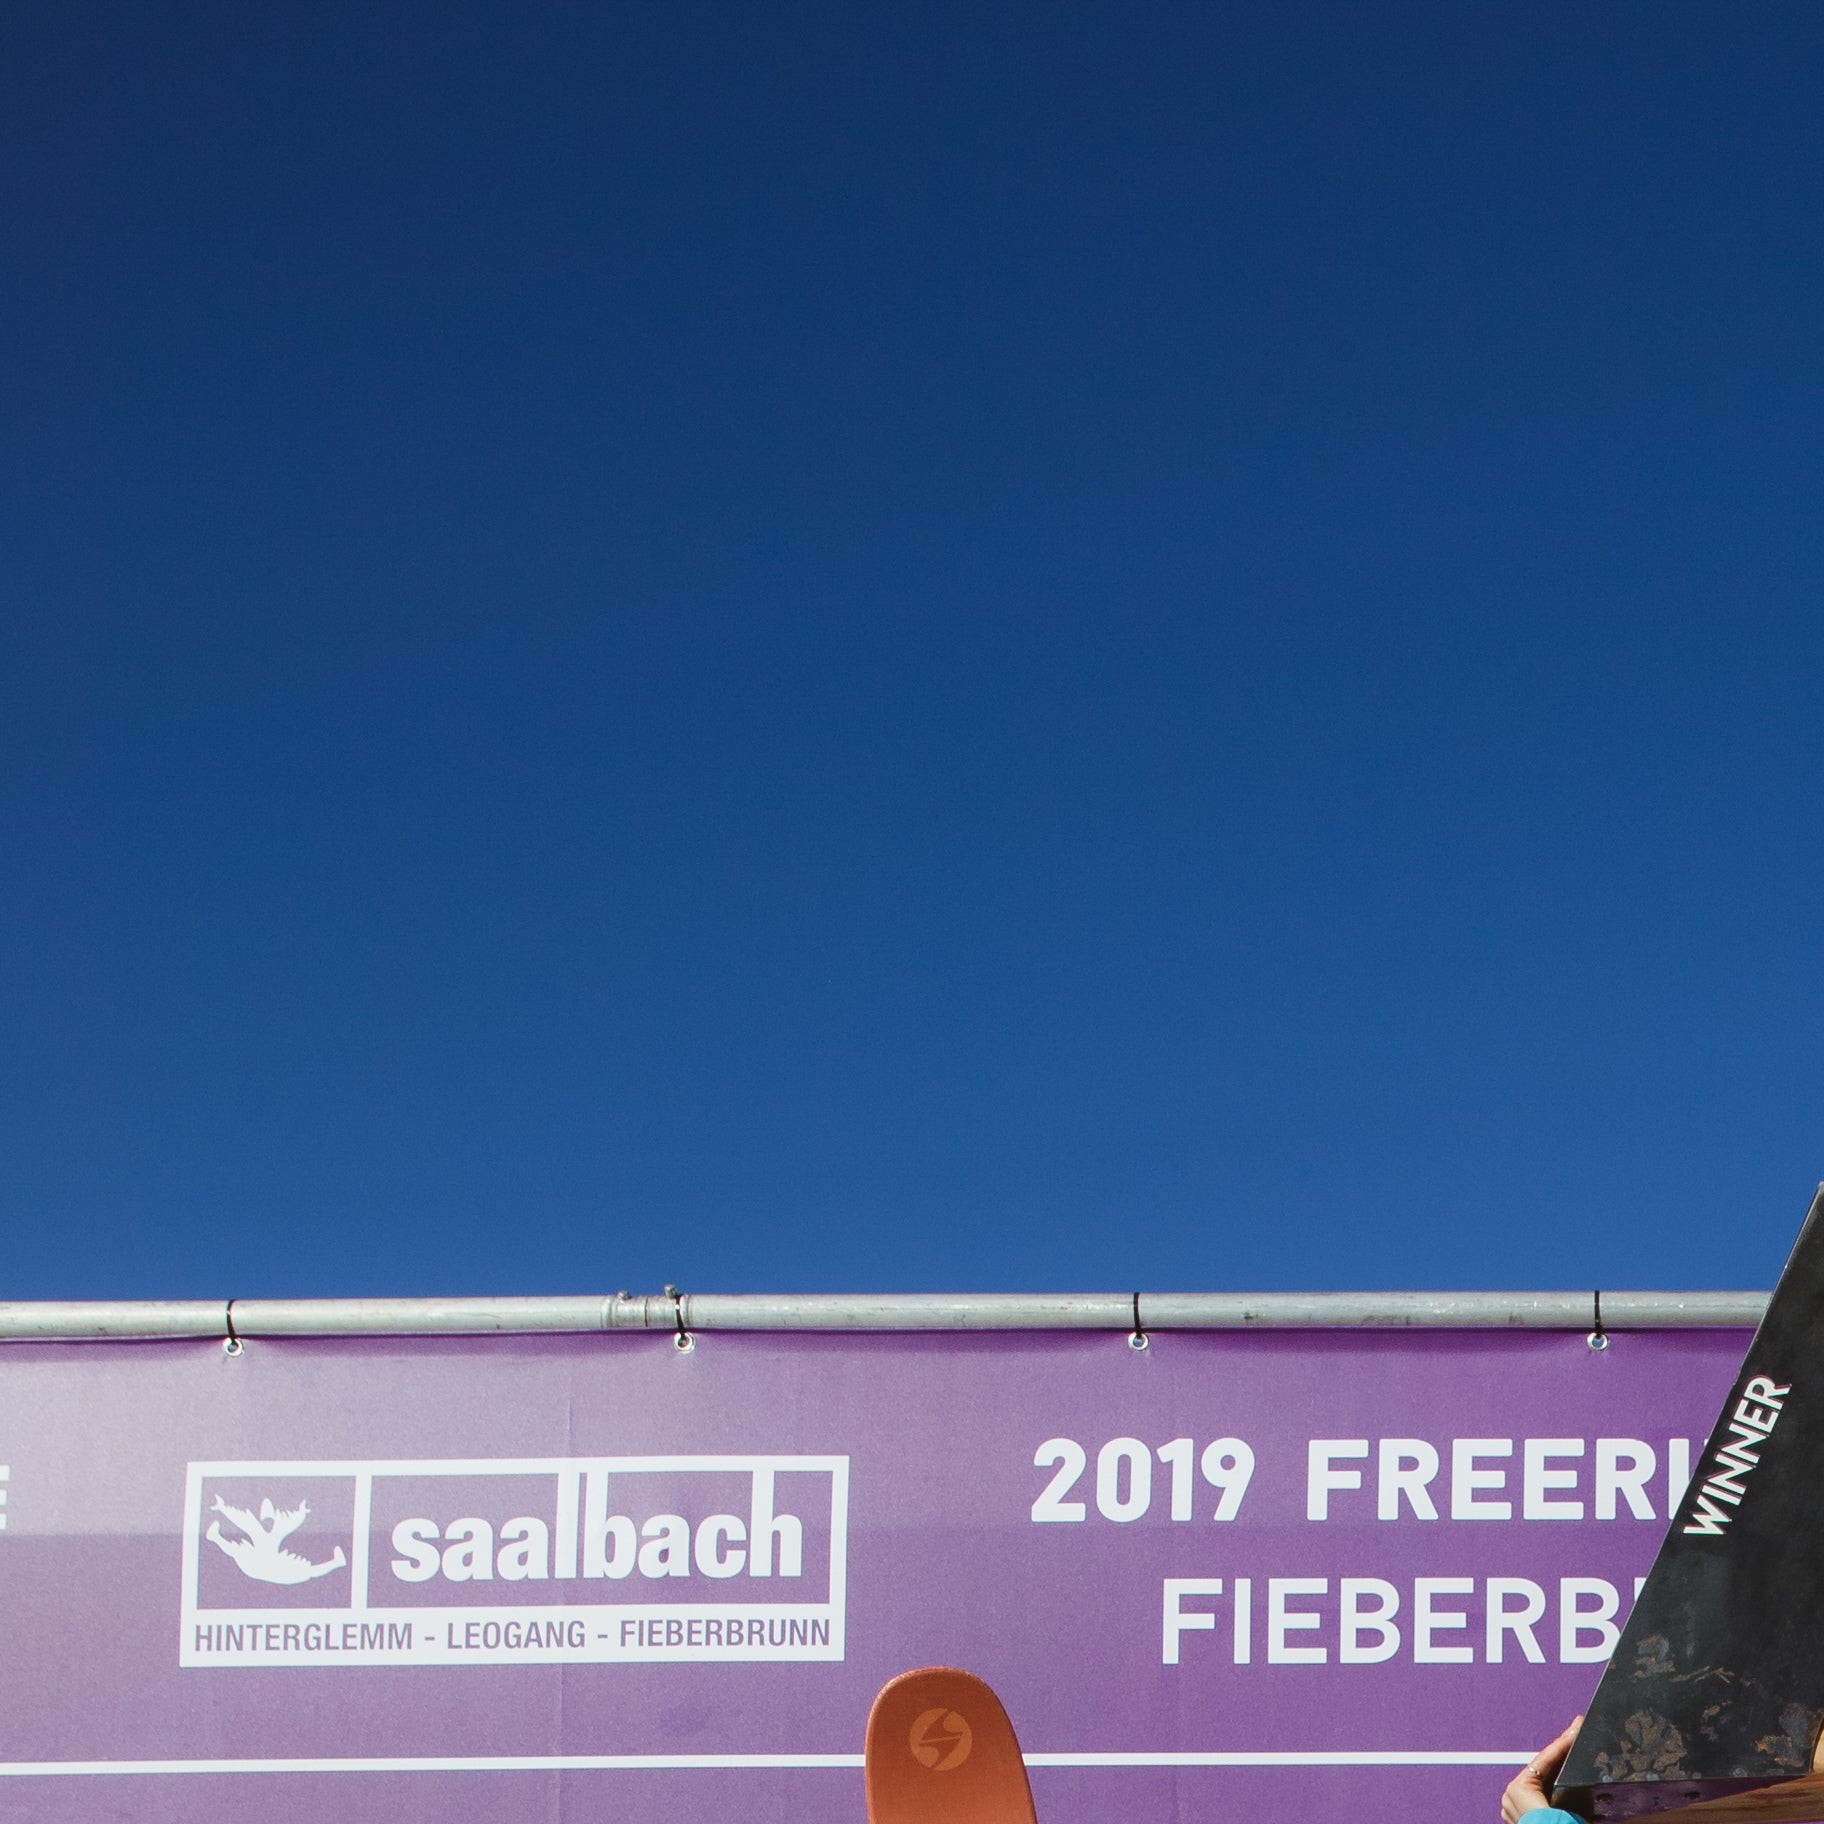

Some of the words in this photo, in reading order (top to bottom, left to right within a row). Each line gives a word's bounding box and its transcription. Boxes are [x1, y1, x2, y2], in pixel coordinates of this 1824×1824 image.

[1031, 1437, 1255, 1523] 2019
[1307, 1437, 1713, 1522] FREERI
[1683, 1375, 1791, 1536] WINNER
[391, 1471, 802, 1582] saalbach
[195, 1622, 412, 1654] HINTERGLEMM
[448, 1620, 585, 1650] LEOGANG
[619, 1618, 831, 1649] FIEBERBRUNN
[1162, 1577, 1640, 1666] FIEBERB
